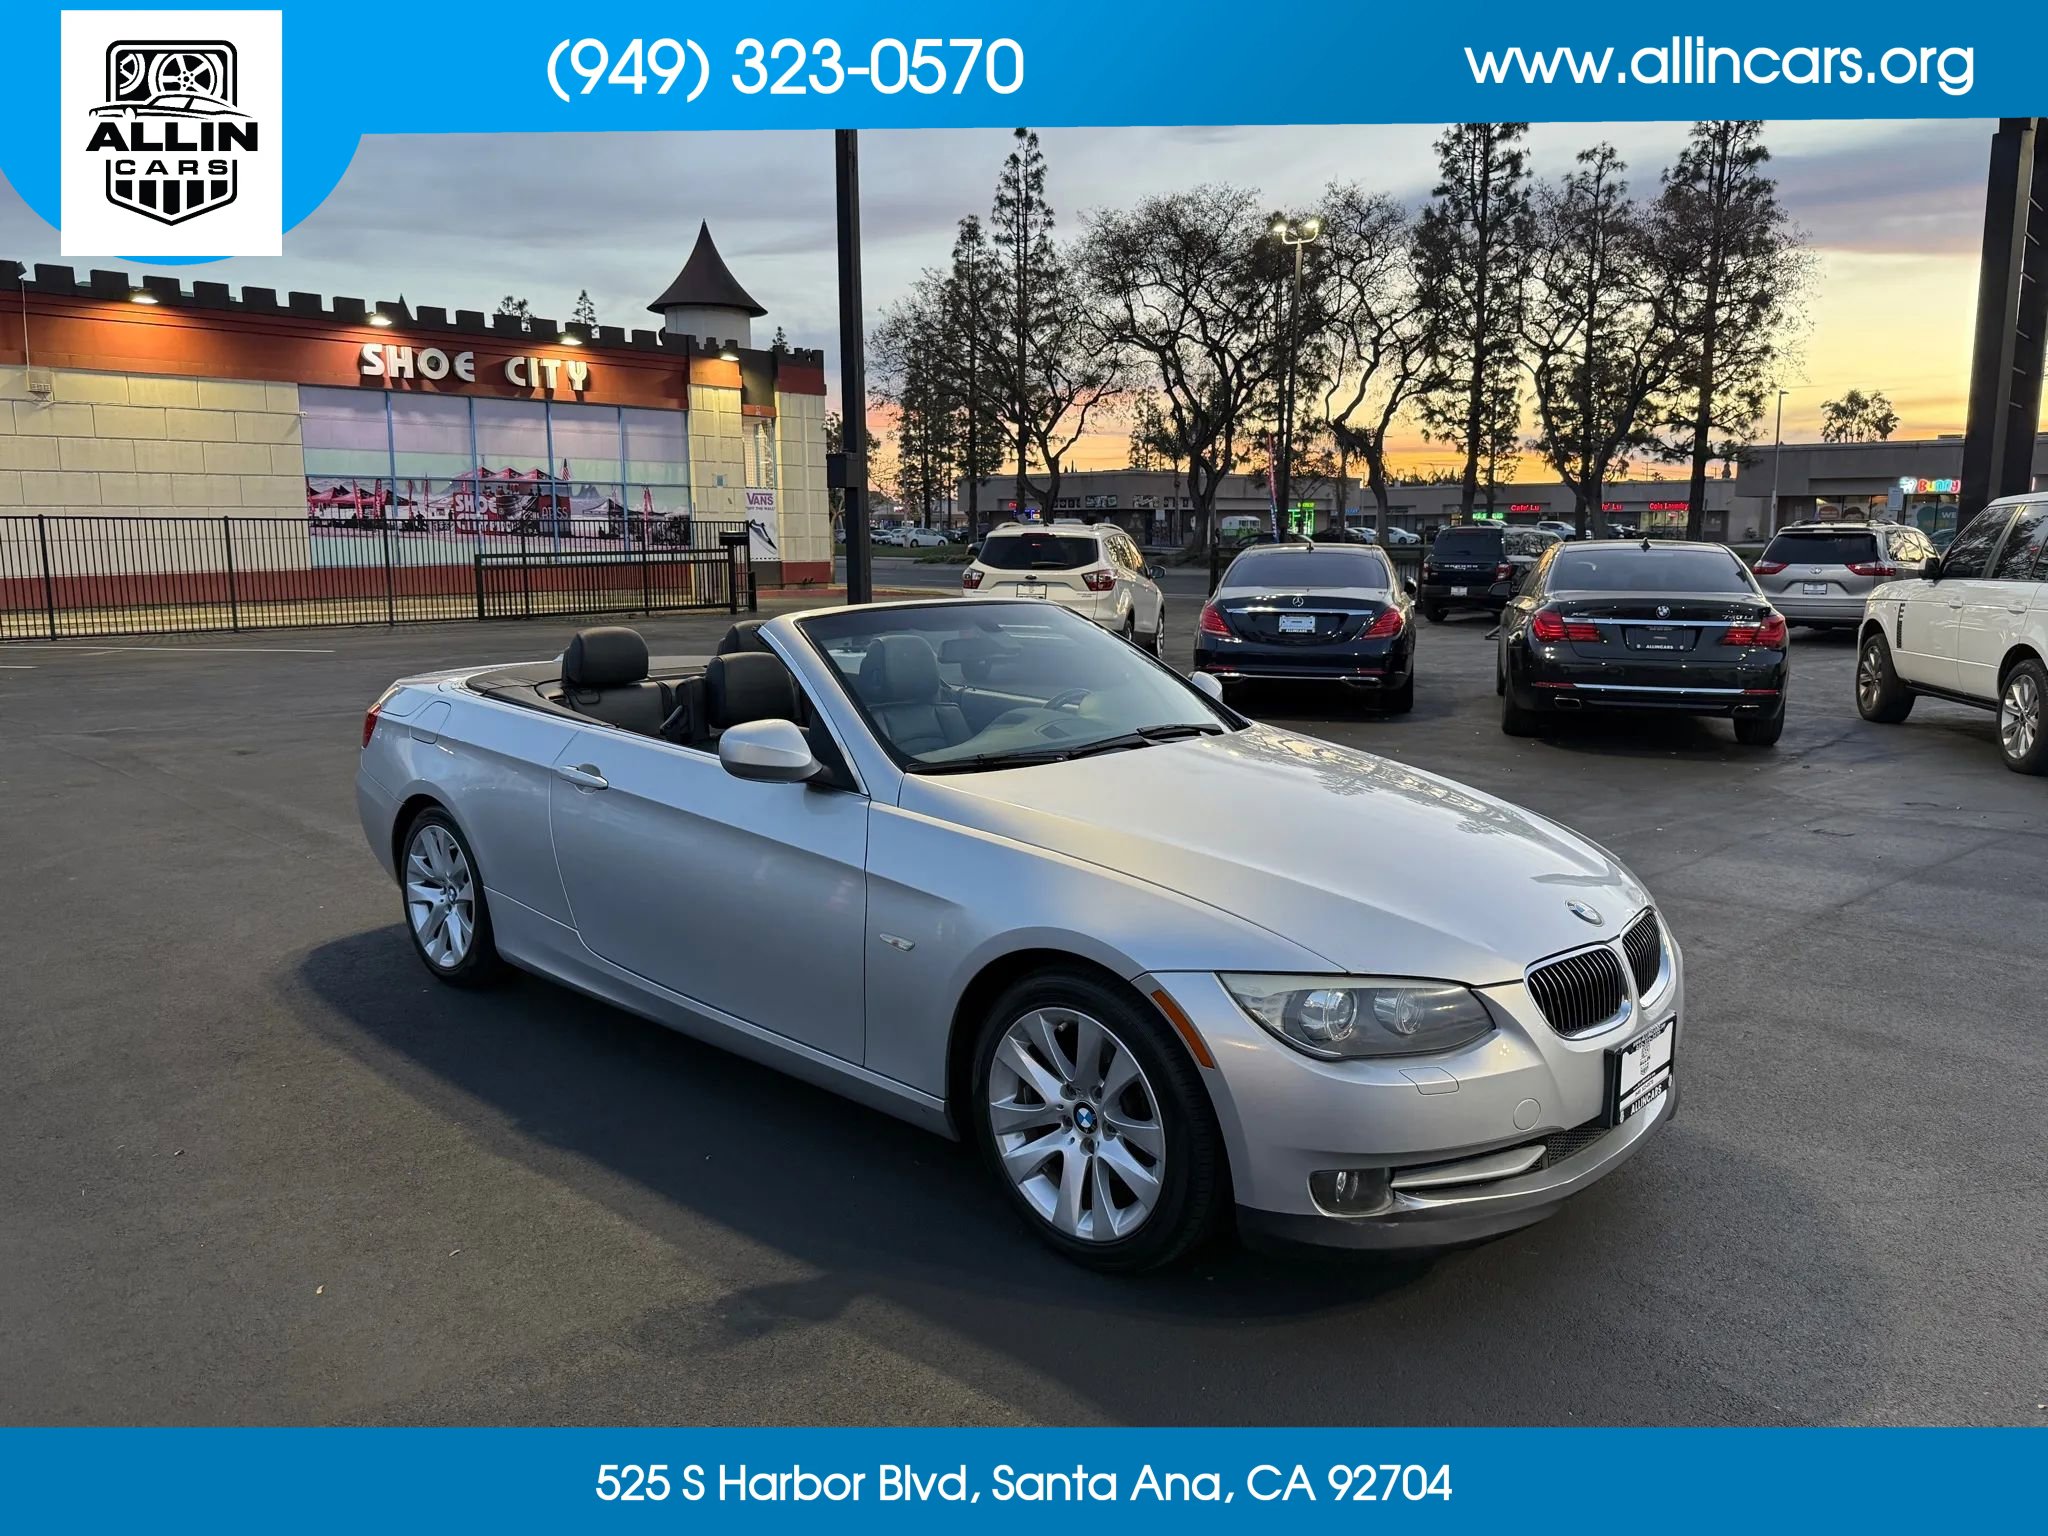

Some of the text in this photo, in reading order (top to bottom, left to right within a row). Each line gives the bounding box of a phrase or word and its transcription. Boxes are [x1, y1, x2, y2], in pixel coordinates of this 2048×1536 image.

[361, 343, 589, 391] SHOE CITY
[1917, 478, 1961, 494] Bunny
[455, 494, 498, 514] SHOE
[746, 492, 774, 506] VANS
[1630, 1084, 1662, 1116] ALLINCARS
